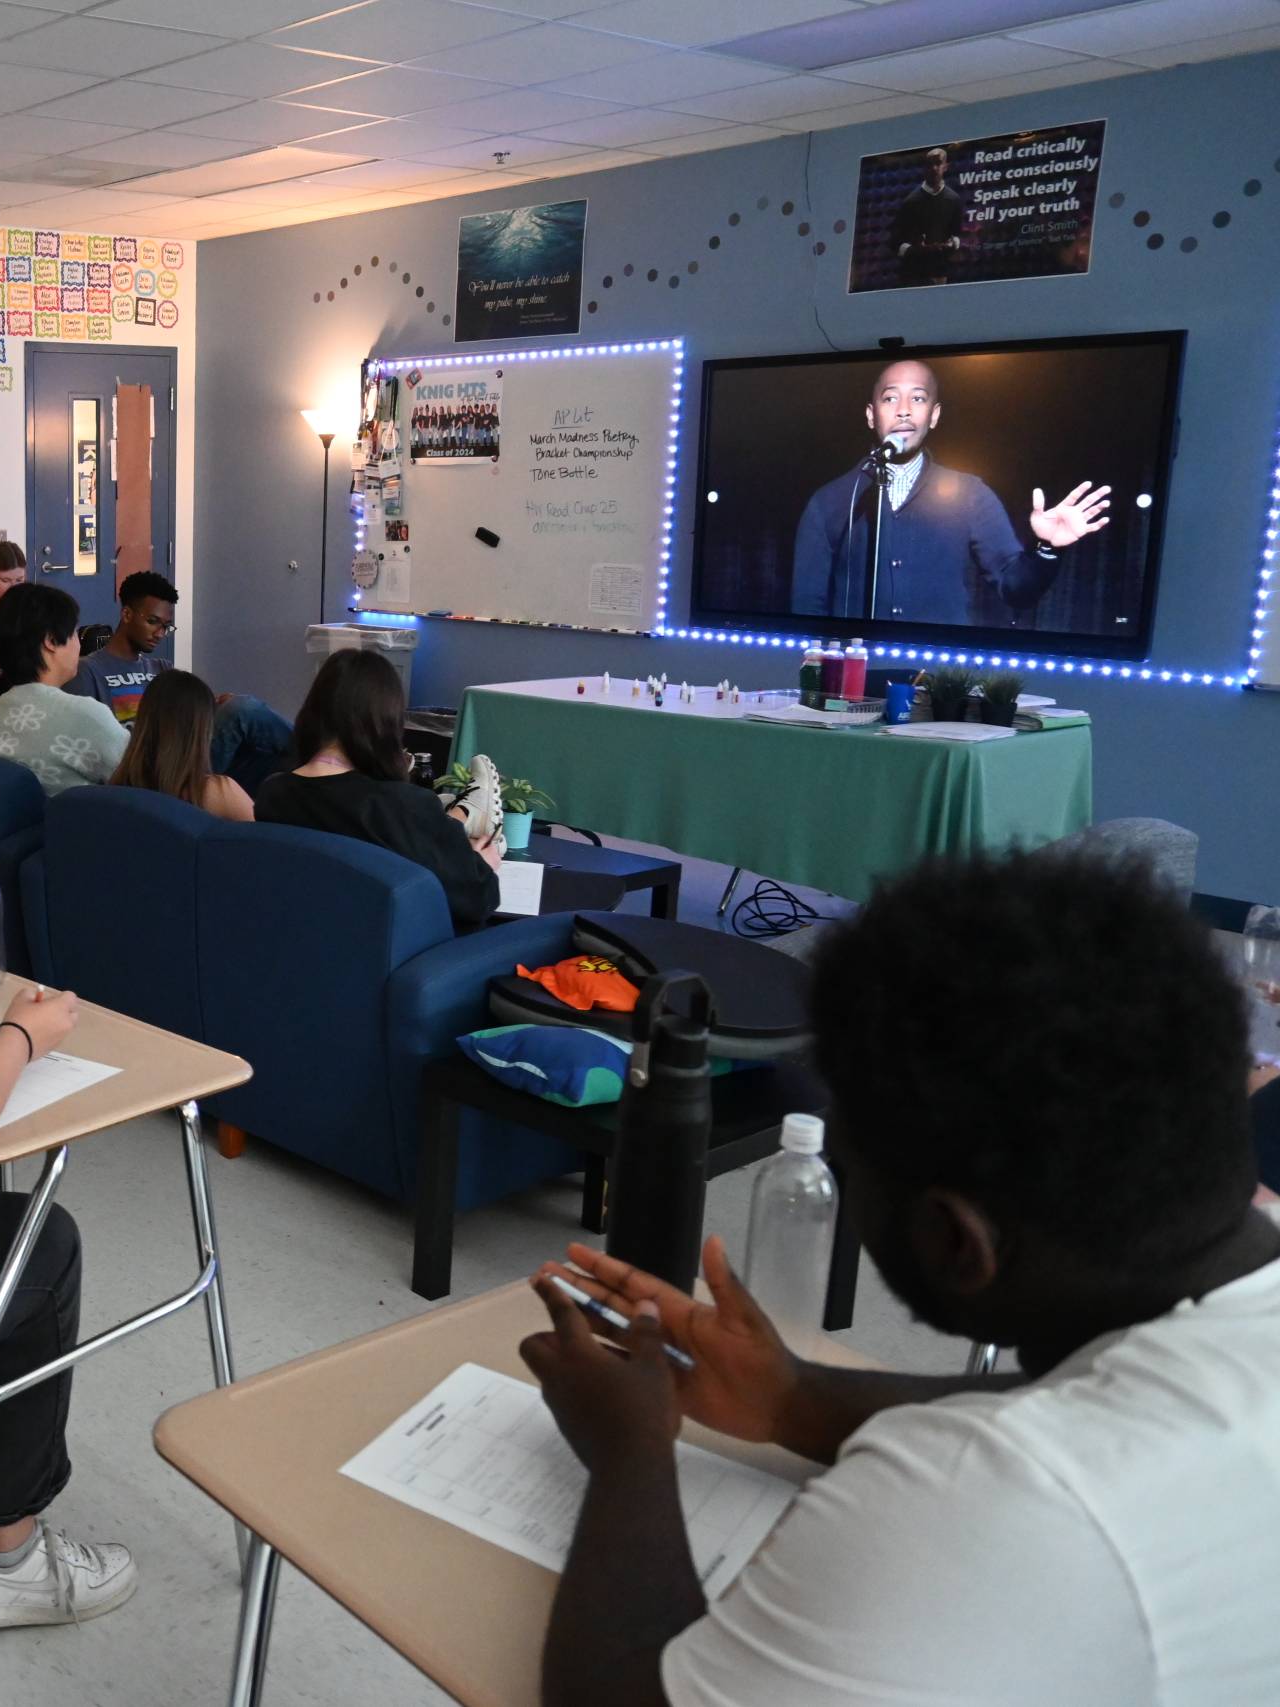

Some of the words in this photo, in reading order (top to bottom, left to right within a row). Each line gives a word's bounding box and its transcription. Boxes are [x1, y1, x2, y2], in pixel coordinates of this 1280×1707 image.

[975, 147, 1012, 164] Read
[1017, 137, 1087, 158] critically
[959, 169, 1001, 185] Write
[1006, 156, 1099, 178] consciously
[973, 188, 1020, 204] Speak
[1024, 180, 1077, 196] clearly
[968, 209, 994, 222] Tell
[999, 207, 1034, 221] your
[1039, 197, 1080, 213] truth
[1021, 223, 1045, 234] Clint
[1047, 220, 1078, 231] Smith
[525, 276, 540, 286] able
[541, 277, 549, 285] to
[551, 272, 570, 284] catch
[555, 410, 570, 425] AP
[530, 434, 555, 445] March
[559, 433, 598, 442] Madness
[426, 448, 444, 456] Class
[536, 448, 570, 461] Bracket
[573, 447, 632, 461] Championship
